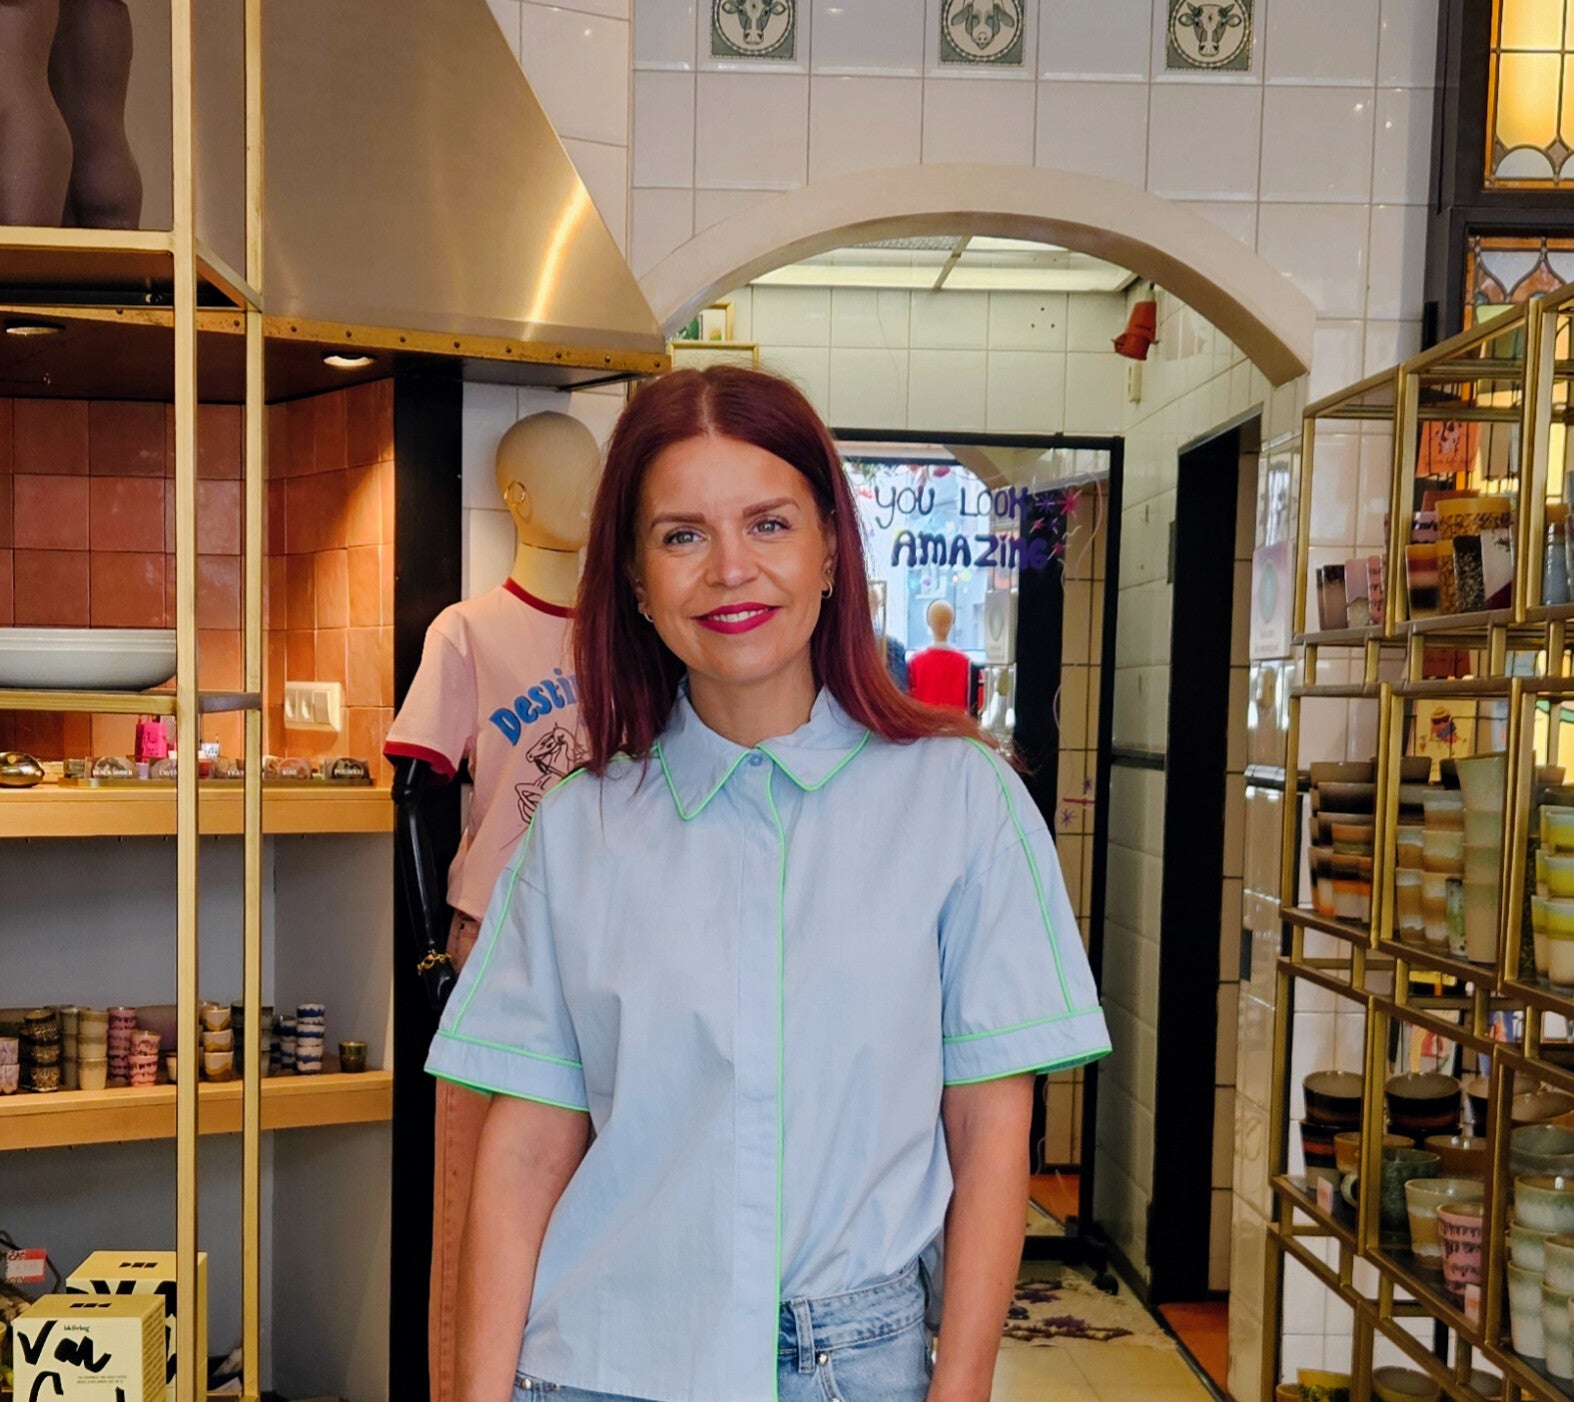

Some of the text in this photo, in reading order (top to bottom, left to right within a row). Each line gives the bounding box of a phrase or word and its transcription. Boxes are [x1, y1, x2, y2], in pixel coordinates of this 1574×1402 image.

[874, 485, 1029, 530] YOU LOOK
[17, 1320, 112, 1373] Van
